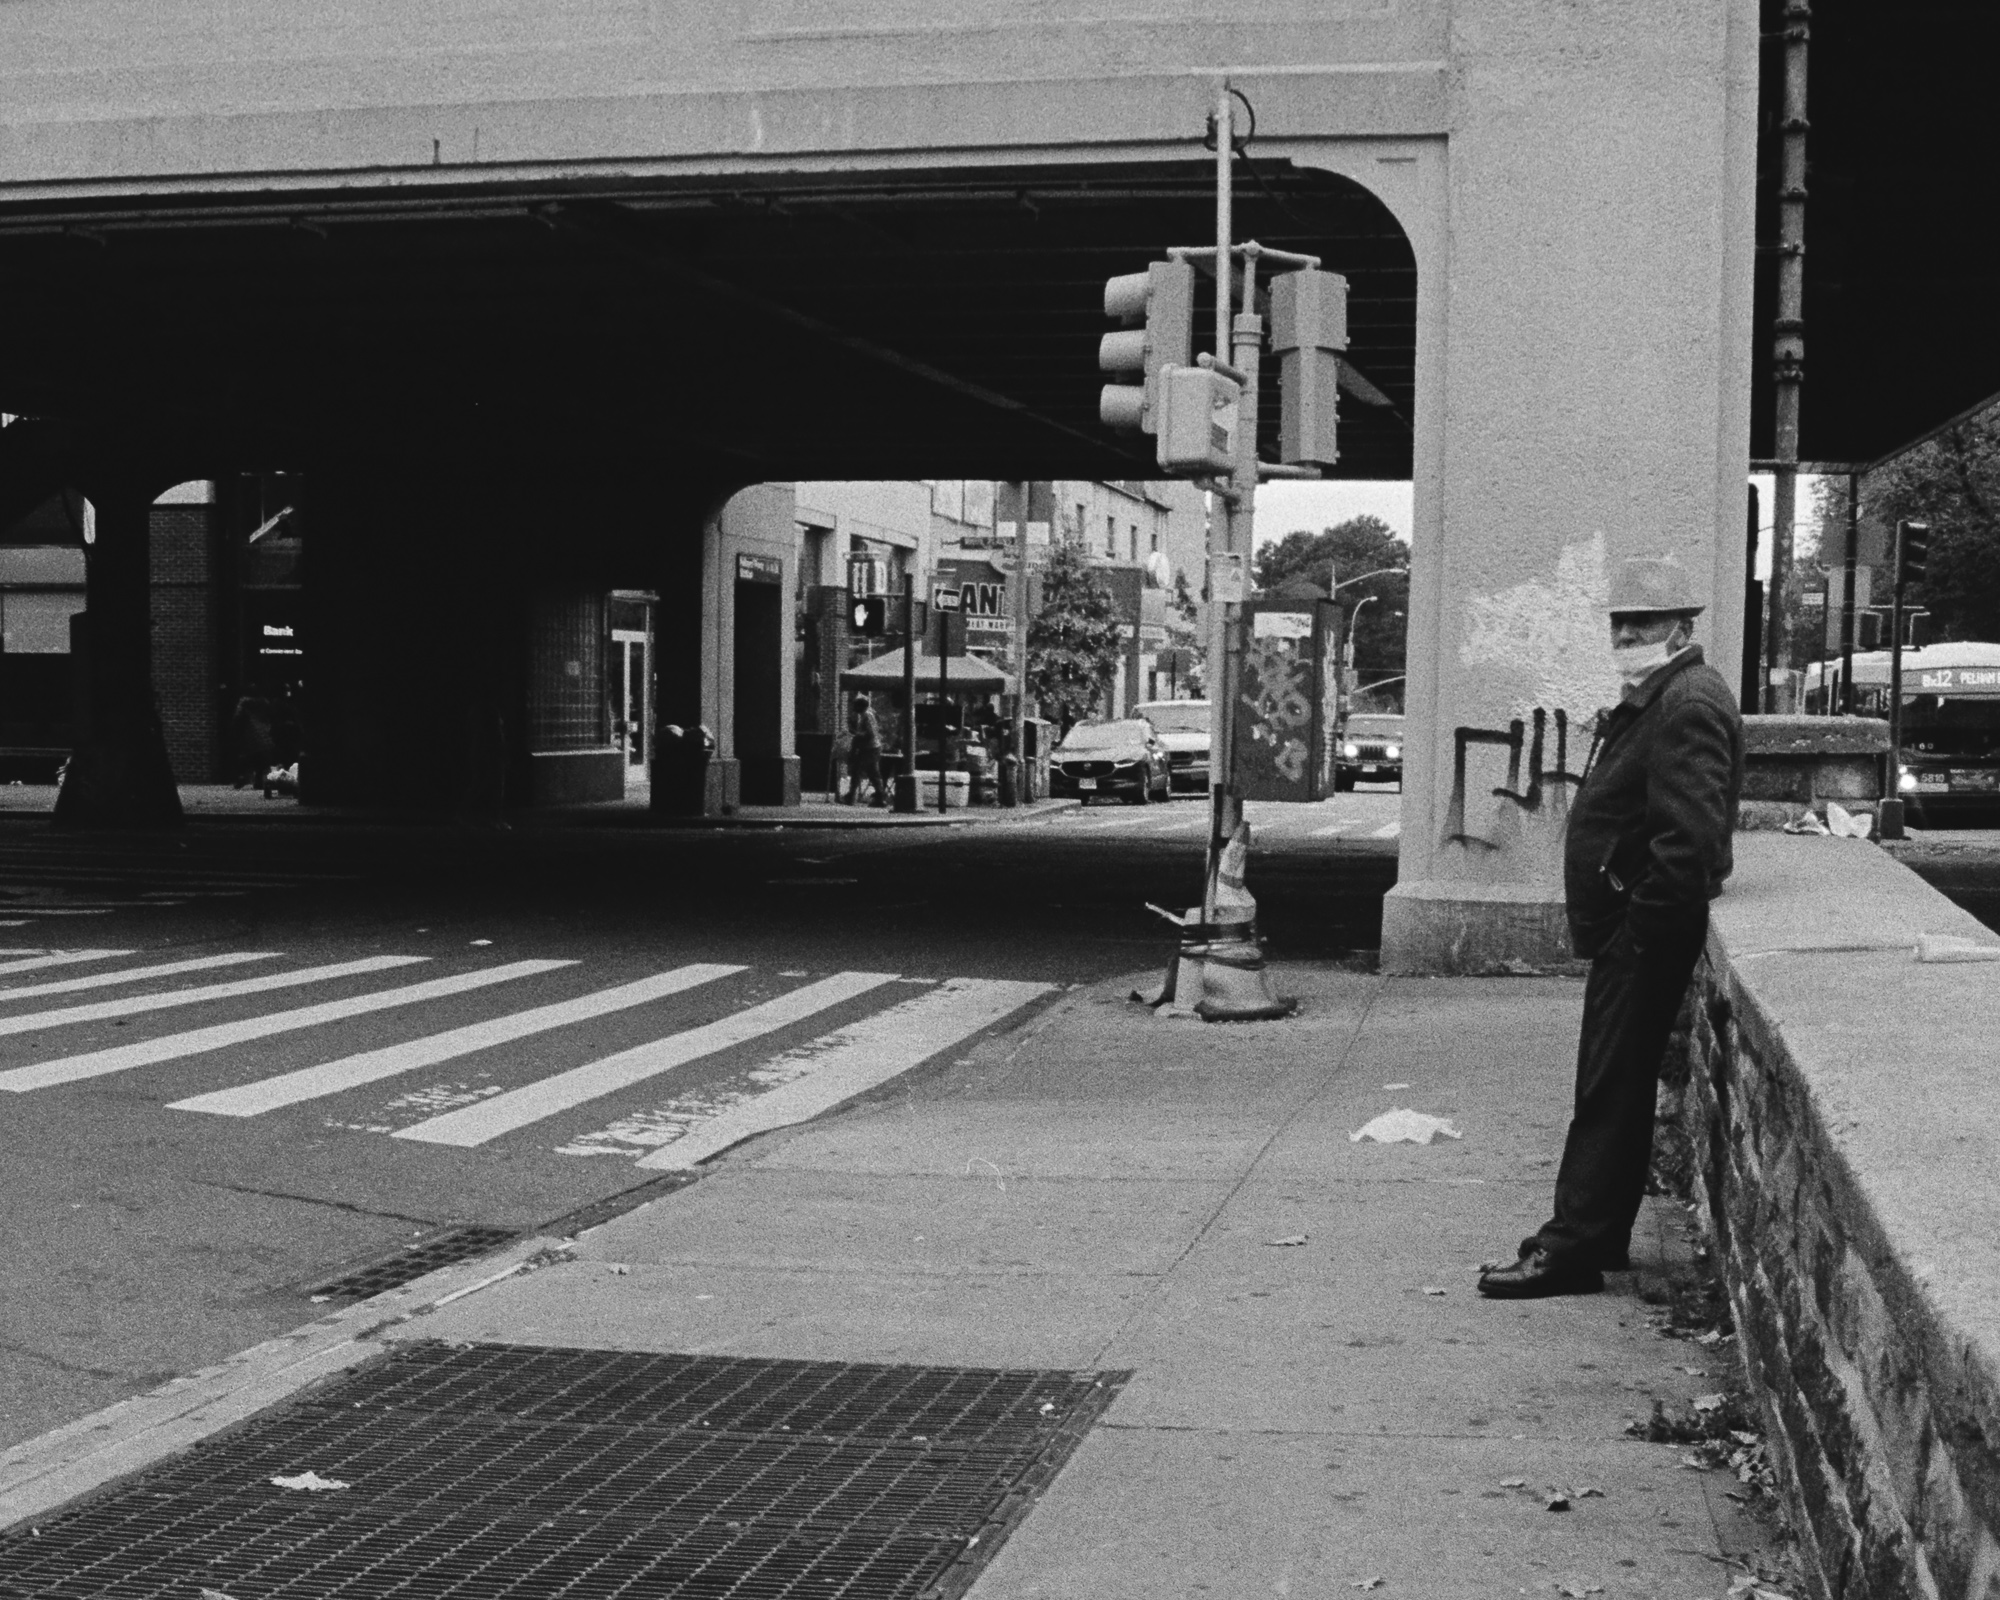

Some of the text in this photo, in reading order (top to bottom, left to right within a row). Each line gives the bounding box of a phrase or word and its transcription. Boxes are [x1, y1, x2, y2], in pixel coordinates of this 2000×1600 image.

[263, 625, 294, 636] Bank
[1922, 670, 1952, 688] Bx12
[1960, 672, 1996, 685] PELHAM
